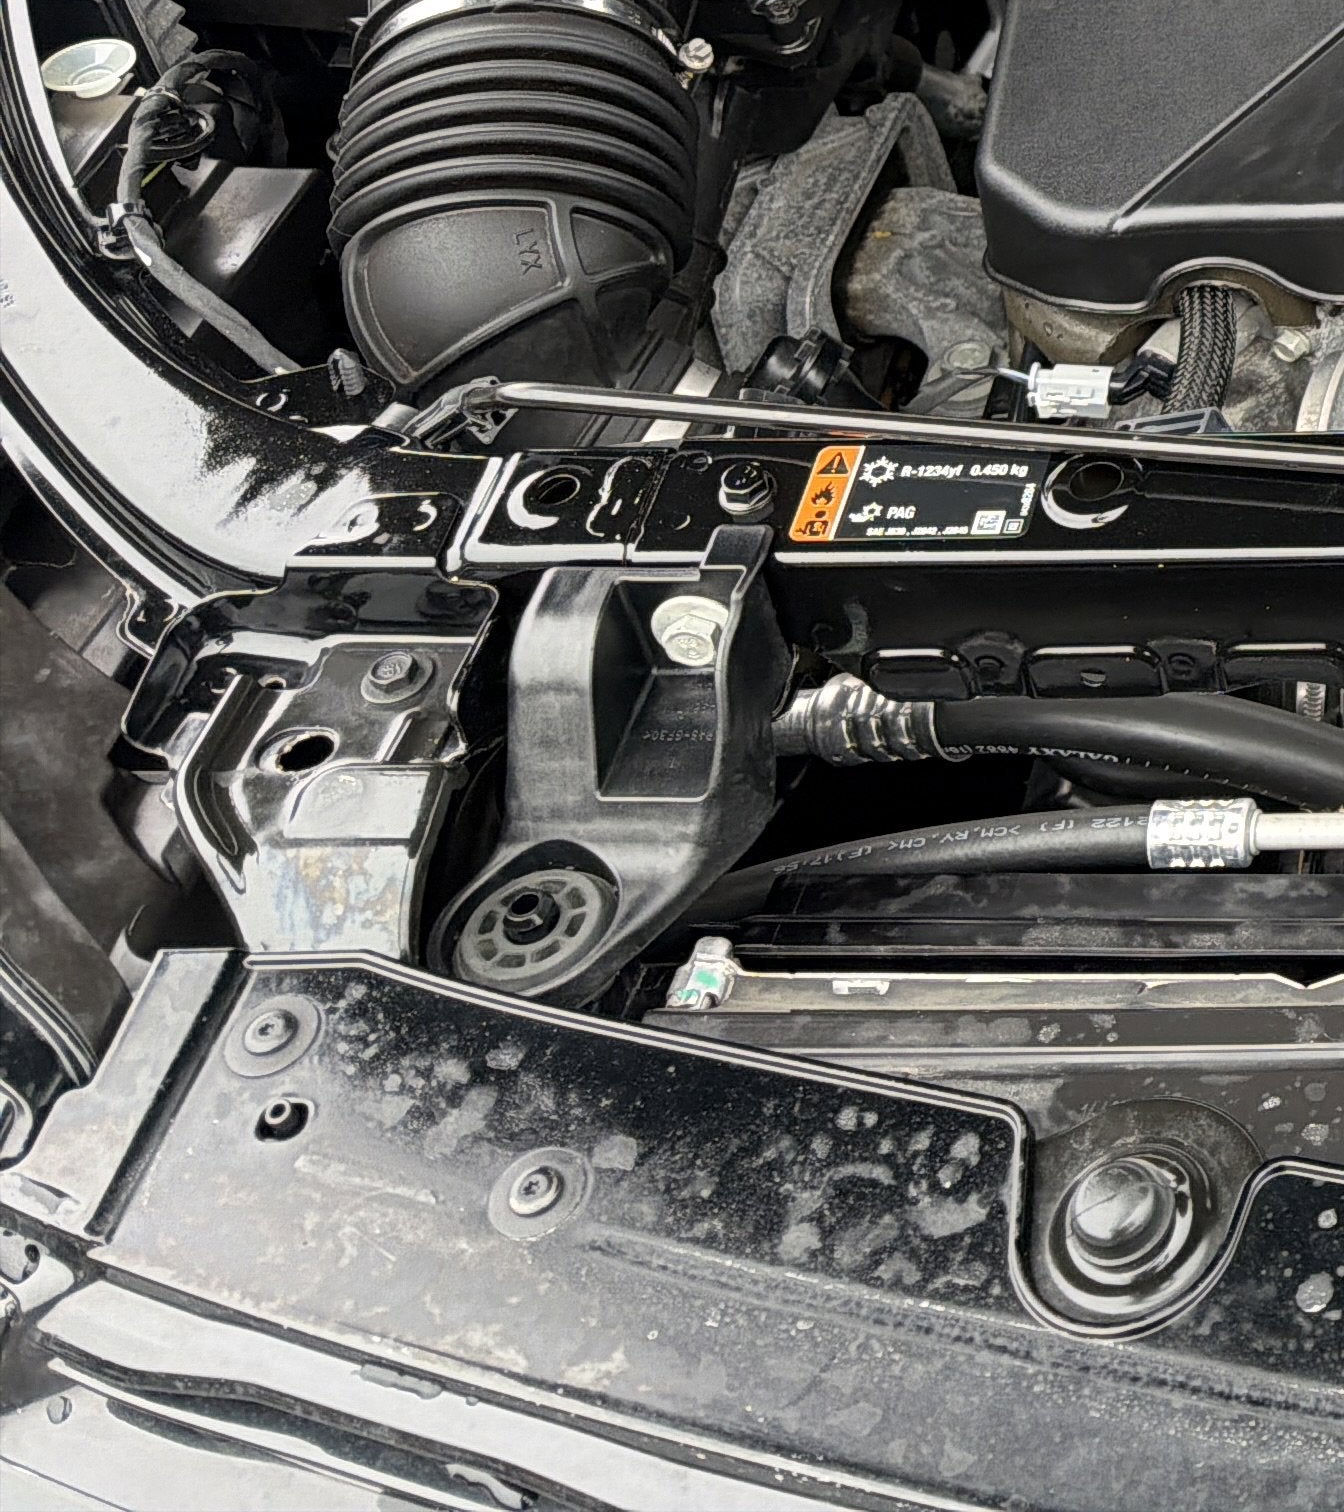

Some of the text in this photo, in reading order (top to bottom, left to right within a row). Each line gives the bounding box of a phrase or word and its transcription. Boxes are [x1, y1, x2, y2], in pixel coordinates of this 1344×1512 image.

[901, 464, 1029, 478] R-1234yf 0.450 kg
[887, 506, 917, 520] PAG
